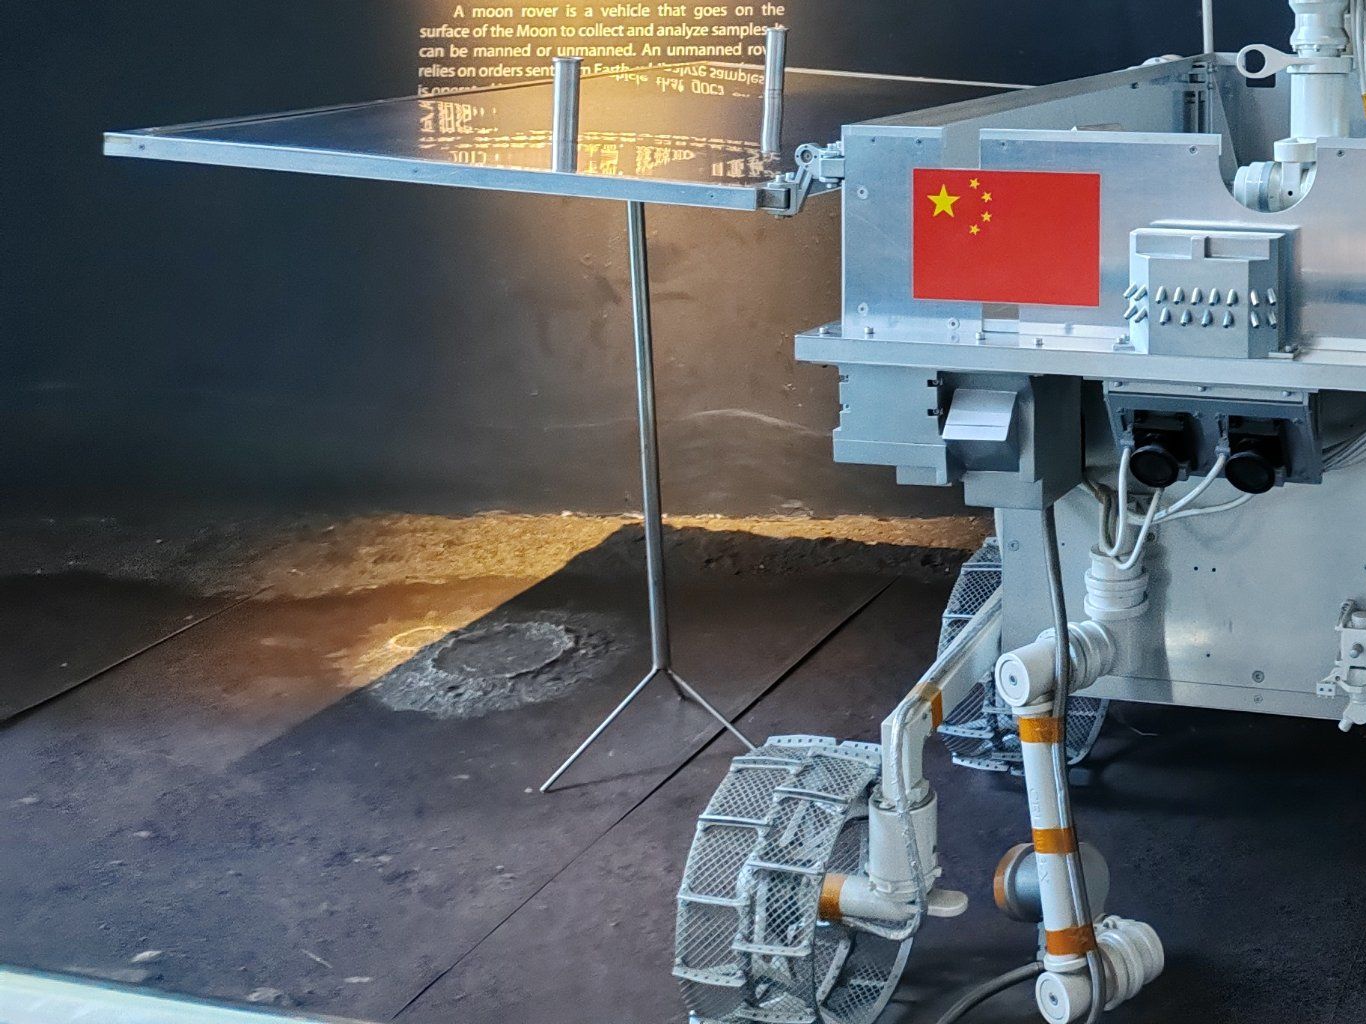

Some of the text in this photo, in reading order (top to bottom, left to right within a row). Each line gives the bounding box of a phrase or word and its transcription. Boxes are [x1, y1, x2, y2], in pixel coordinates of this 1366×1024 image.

[453, 2, 785, 19] A moon rover is a vehicle that goes on the
[419, 24, 470, 38] surface
[473, 24, 488, 38] of
[490, 24, 514, 38] the
[516, 25, 557, 38] Moon
[561, 25, 575, 38] to
[578, 23, 625, 38] collect
[627, 23, 654, 37] and
[657, 23, 709, 40] analyze
[418, 46, 444, 58] can
[450, 44, 468, 58] be
[473, 44, 531, 58] manned
[536, 46, 552, 57] or
[557, 43, 636, 57] unmanned.
[642, 45, 661, 57] An
[667, 42, 742, 56] unmanned
[418, 64, 456, 78] relies
[457, 66, 476, 77] on
[478, 64, 522, 78] orders
[525, 65, 555, 77] sent
